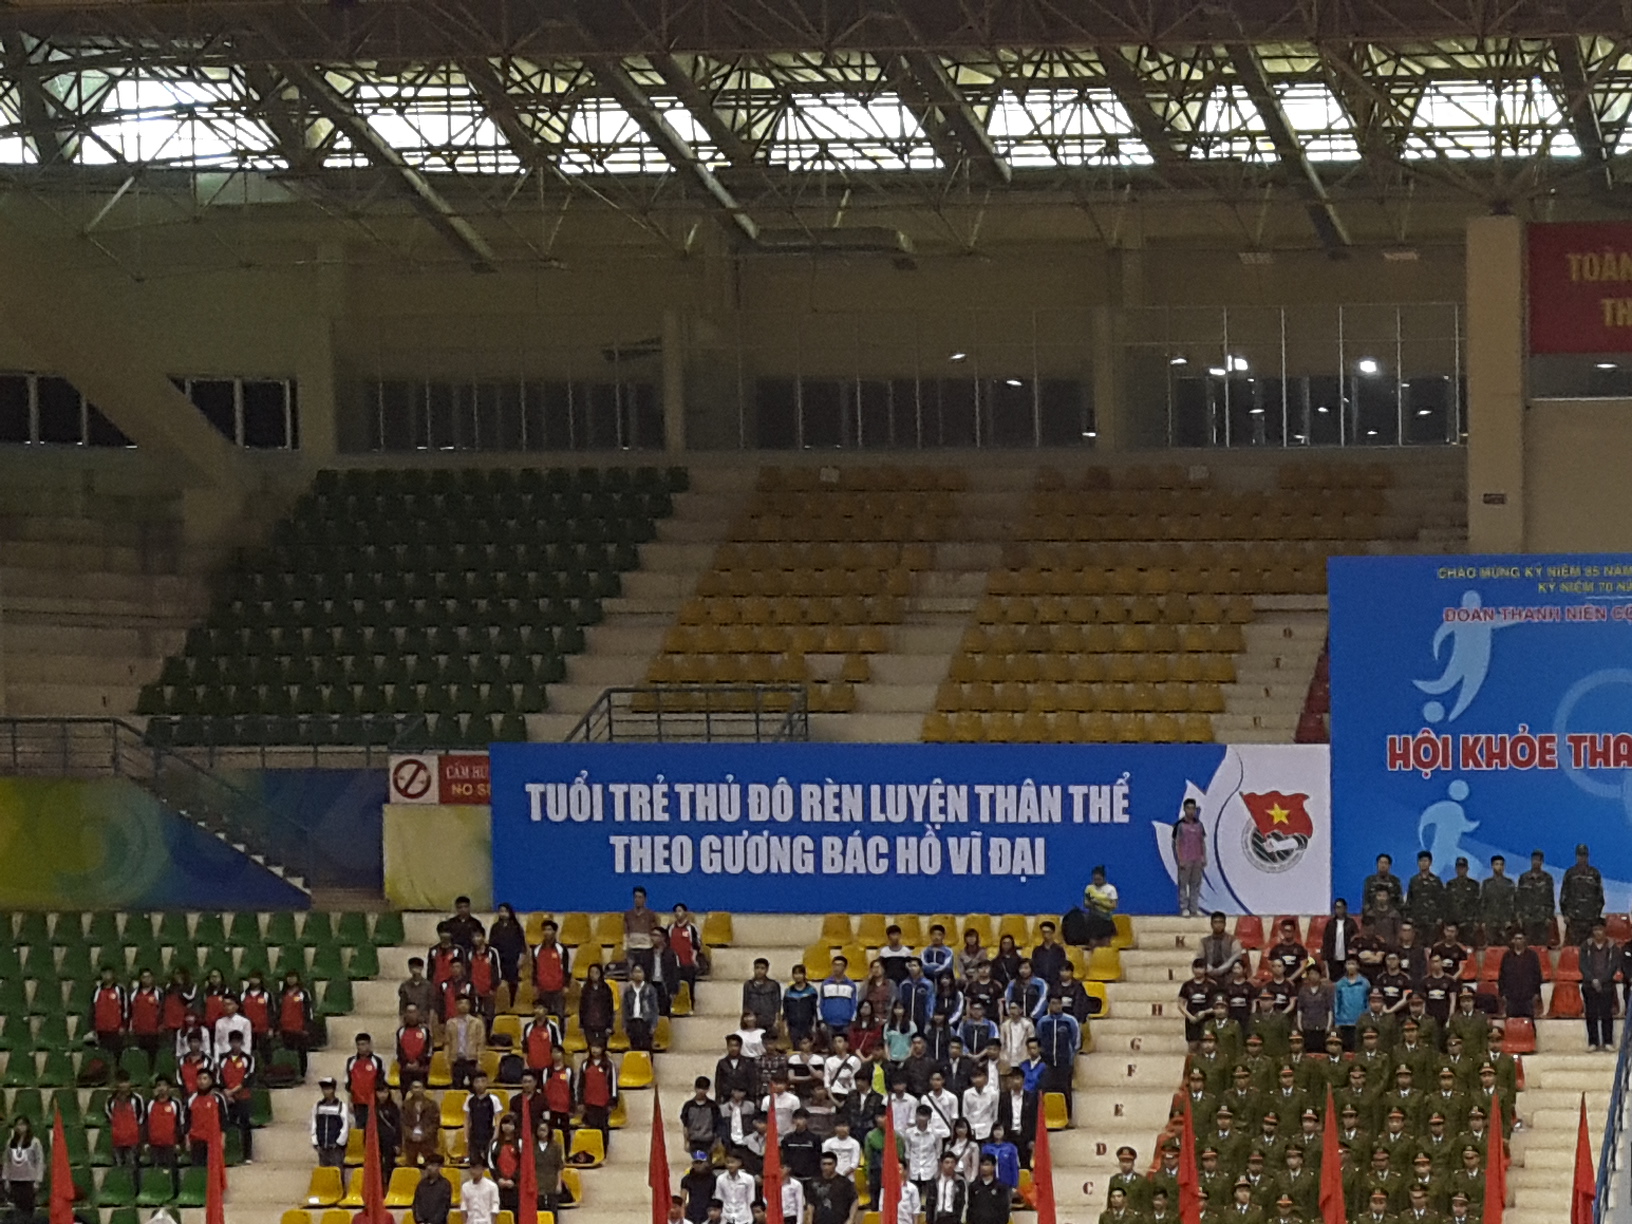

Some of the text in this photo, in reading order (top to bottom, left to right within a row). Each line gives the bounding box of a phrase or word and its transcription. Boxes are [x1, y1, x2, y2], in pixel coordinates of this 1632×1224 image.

[1500, 604, 1561, 623] THANH
[1566, 602, 1608, 622] NIÊN
[1387, 727, 1452, 779] HỘI
[1460, 723, 1559, 771] KHỎE
[451, 783, 473, 796] NO
[525, 769, 1131, 830] TUỔI TRẺ THỦ ĐÔ RÈN LUYỆN THÂN THỂ
[609, 824, 1046, 883] THEO GƯƠNG BÁC HỒ VĨ ĐẠI
[1095, 1143, 1107, 1156] D
[1082, 1182, 1094, 1195] C
